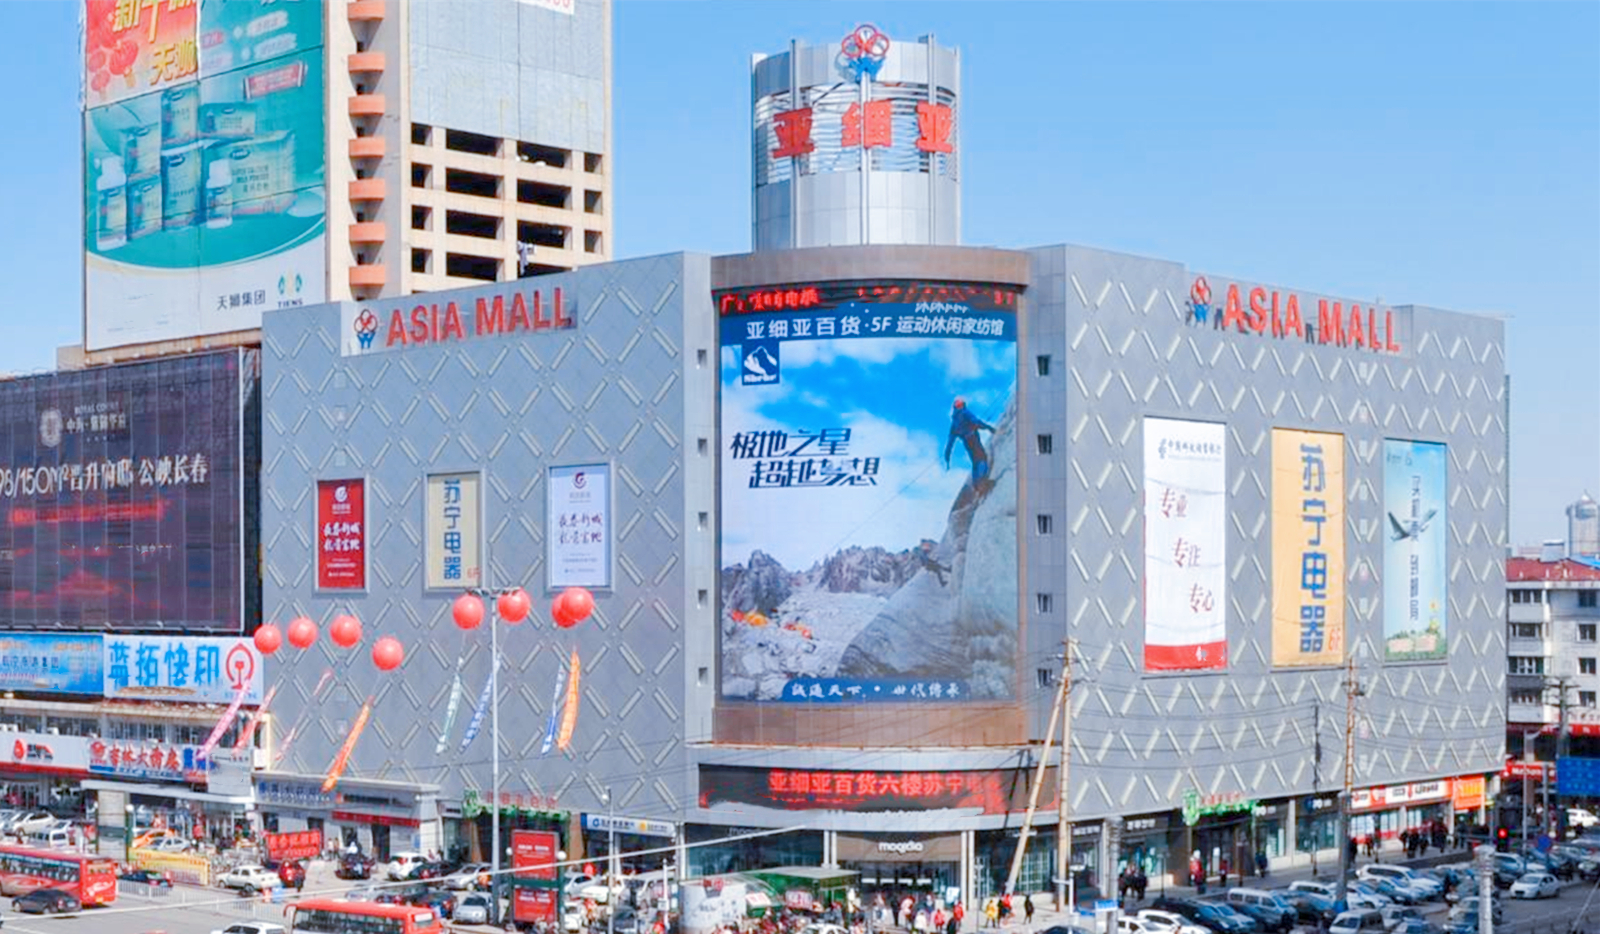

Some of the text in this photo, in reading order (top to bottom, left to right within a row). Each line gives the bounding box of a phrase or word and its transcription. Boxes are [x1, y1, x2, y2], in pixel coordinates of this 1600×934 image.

[772, 98, 955, 159] 亚细亚
[386, 286, 573, 346] ASIA MALL
[1222, 283, 1400, 352] ASIA MALL
[730, 428, 852, 459] 极地之星
[444, 478, 461, 580] 苏宁电器
[1159, 487, 1188, 518] 专业
[1173, 536, 1202, 567] 专注
[1300, 443, 1327, 653] 苏宁电器
[1189, 582, 1215, 613] 专心
